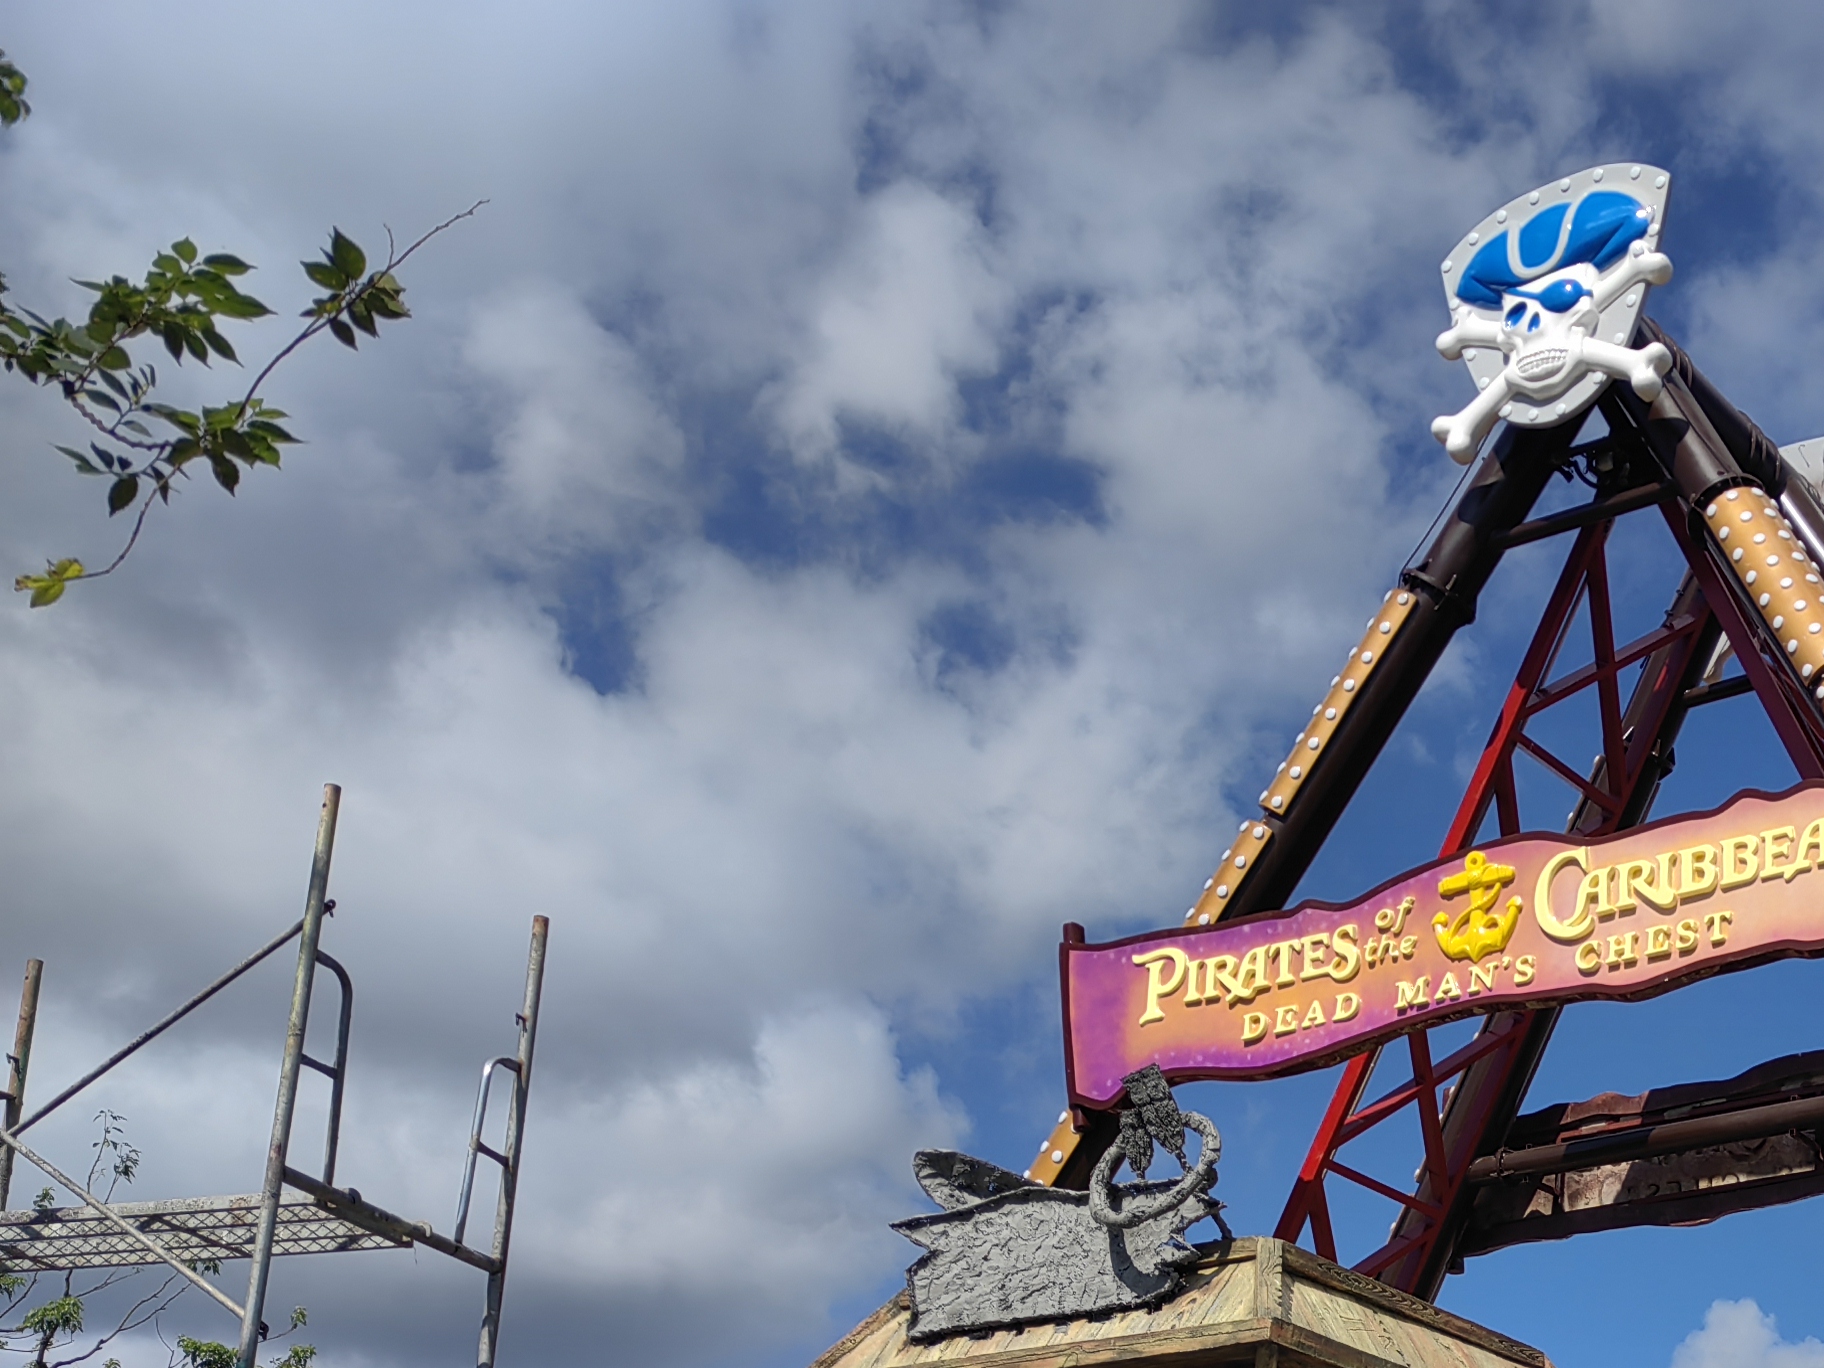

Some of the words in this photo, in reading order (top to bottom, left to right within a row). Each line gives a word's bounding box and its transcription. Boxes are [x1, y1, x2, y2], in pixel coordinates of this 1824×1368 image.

[1363, 932, 1418, 965] the
[1374, 896, 1416, 935] of
[1132, 924, 1361, 1026] PIRATES
[1241, 991, 1362, 1044] DEAD
[1393, 953, 1537, 1011] MAN'S
[1574, 910, 1734, 975] CHEST
